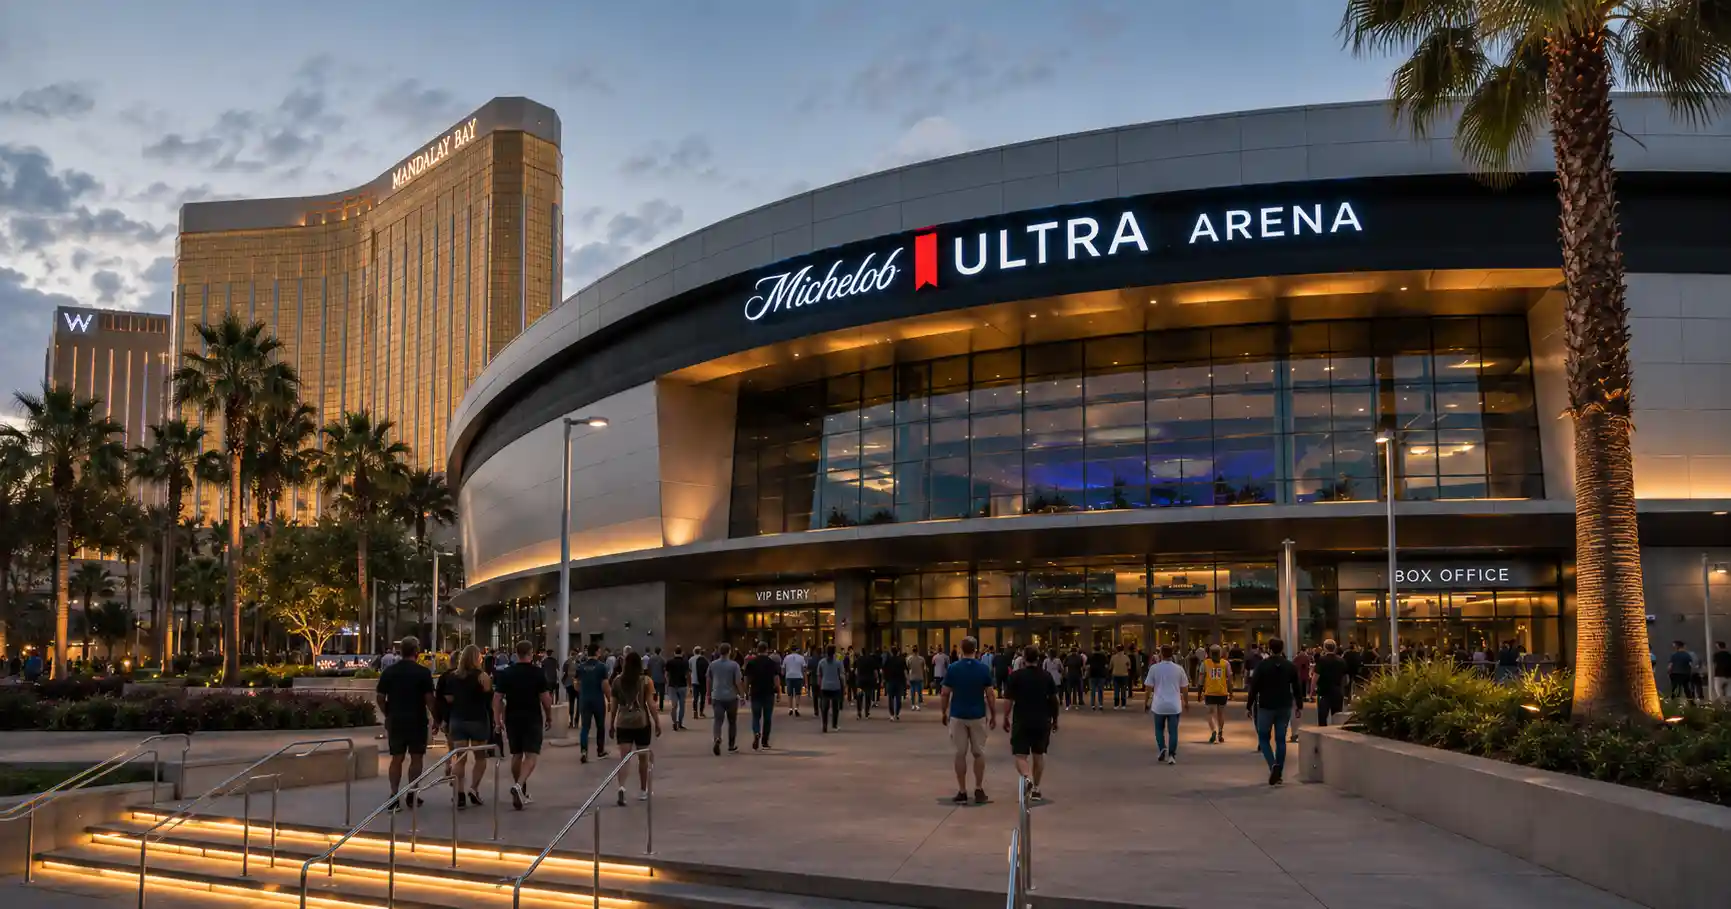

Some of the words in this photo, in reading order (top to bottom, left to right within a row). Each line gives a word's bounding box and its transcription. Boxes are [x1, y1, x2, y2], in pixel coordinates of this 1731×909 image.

[392, 136, 451, 189] MANDALAY
[455, 117, 477, 149] BAY
[744, 247, 904, 321] Michelob
[955, 211, 1149, 275] ULTRA
[1189, 202, 1363, 244] ARENA
[63, 312, 94, 333] W
[1395, 569, 1432, 582] BOX
[1440, 568, 1509, 582] OFFICE
[756, 591, 772, 601] VIP
[776, 589, 810, 601] ENTRY
